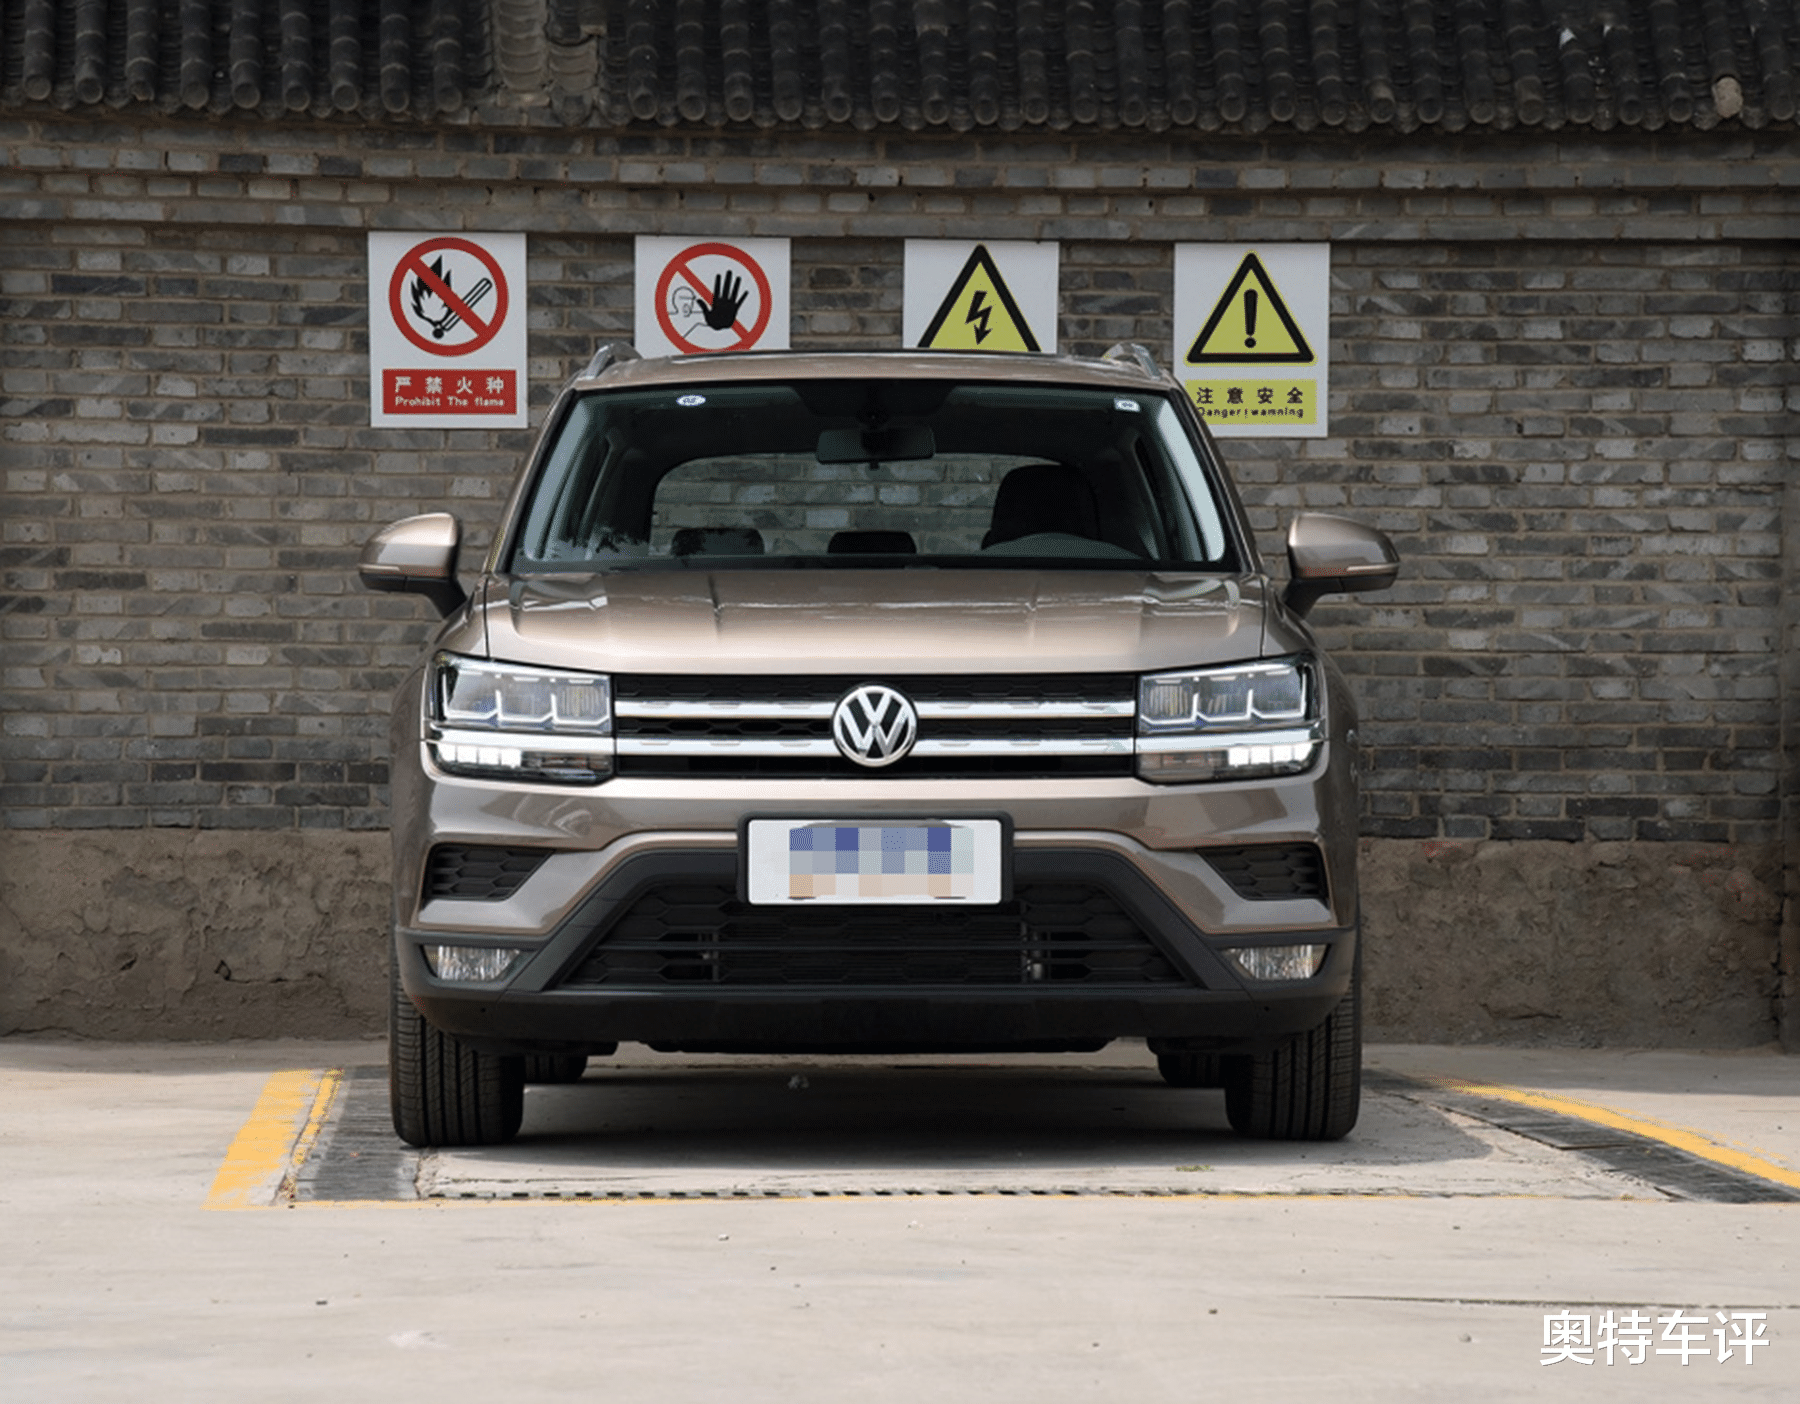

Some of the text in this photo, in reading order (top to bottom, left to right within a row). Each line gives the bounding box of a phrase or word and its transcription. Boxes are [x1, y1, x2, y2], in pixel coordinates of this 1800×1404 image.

[395, 376, 504, 394] 严禁火种
[395, 396, 504, 407] Prohibit The flame
[1196, 386, 1303, 404] 注意安全
